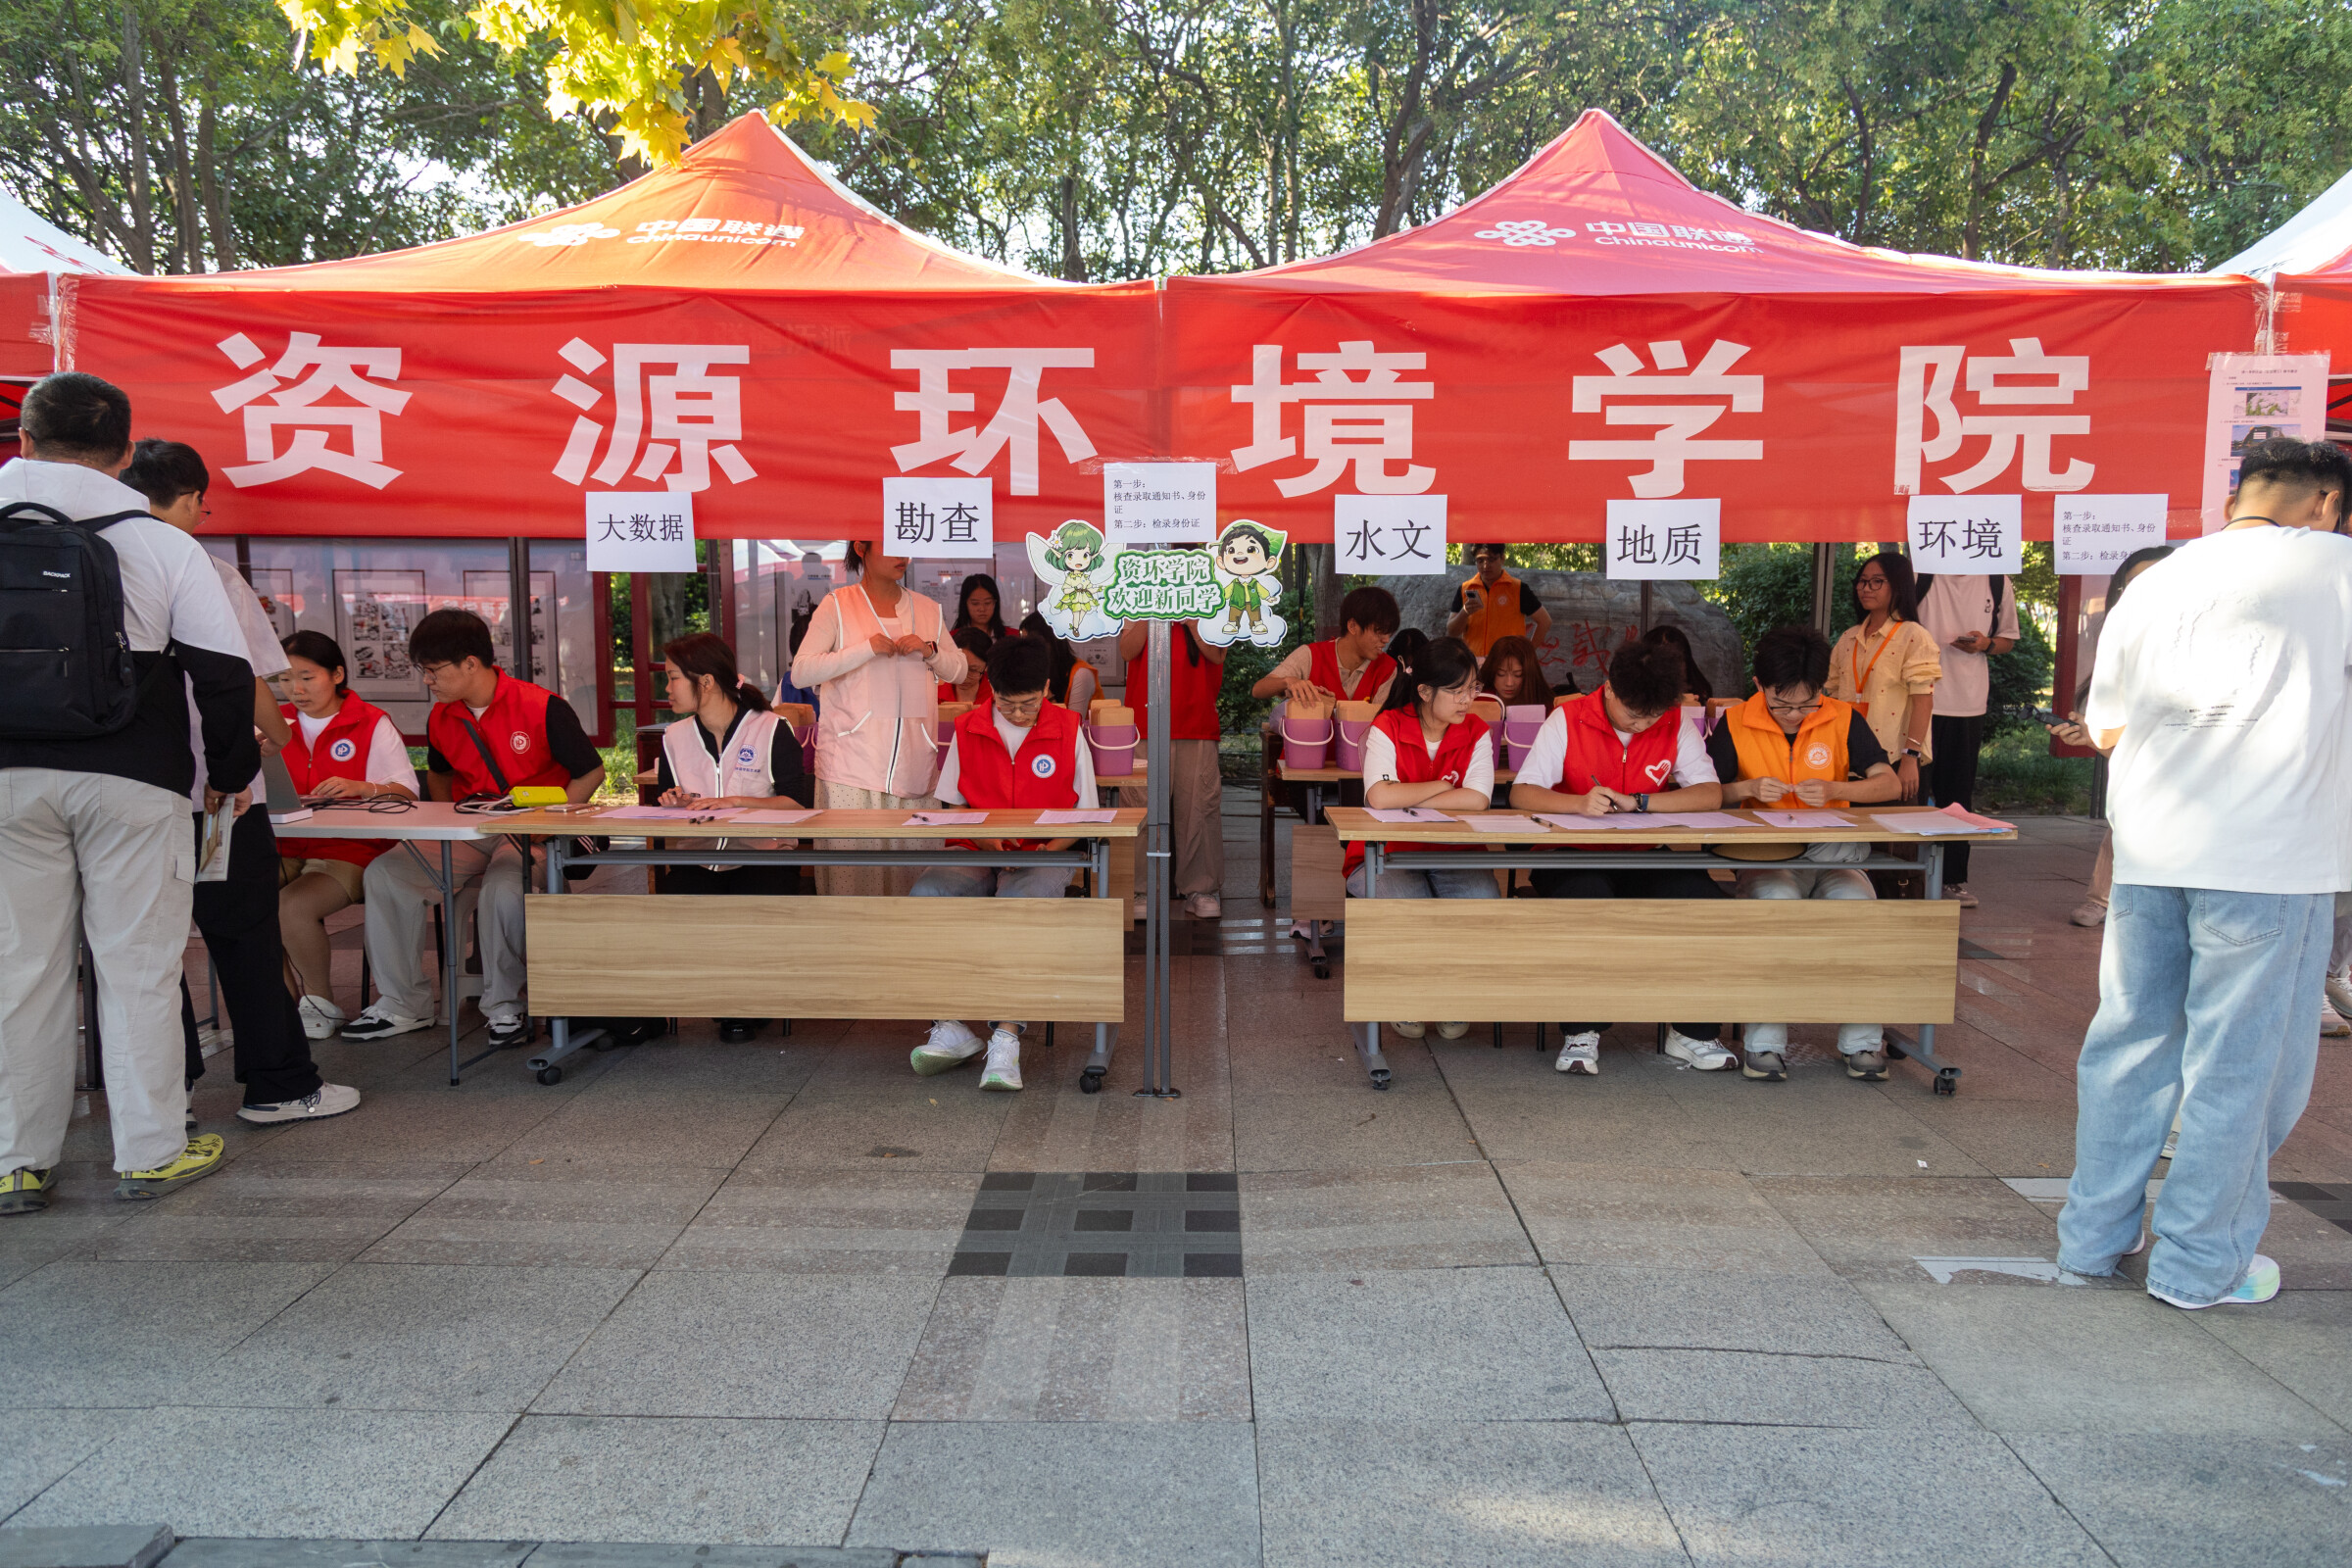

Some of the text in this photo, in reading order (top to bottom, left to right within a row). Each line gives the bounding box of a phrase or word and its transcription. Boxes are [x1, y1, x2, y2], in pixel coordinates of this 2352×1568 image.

[211, 331, 2094, 499] 资源环境学院
[1113, 490, 1206, 502] 核查录取通知书、身份
[1114, 505, 1123, 514] 证
[597, 513, 684, 543] 大数据
[894, 501, 980, 544] 勘查
[2062, 522, 2156, 534] 核查录取通知书、身份
[1345, 518, 1432, 562] 水文
[1616, 523, 1702, 566] 地质
[1918, 517, 2003, 560] 环境
[2062, 536, 2072, 546] 证
[1122, 558, 1208, 582] 资环学院
[1110, 586, 1219, 611] 欢迎新同学
